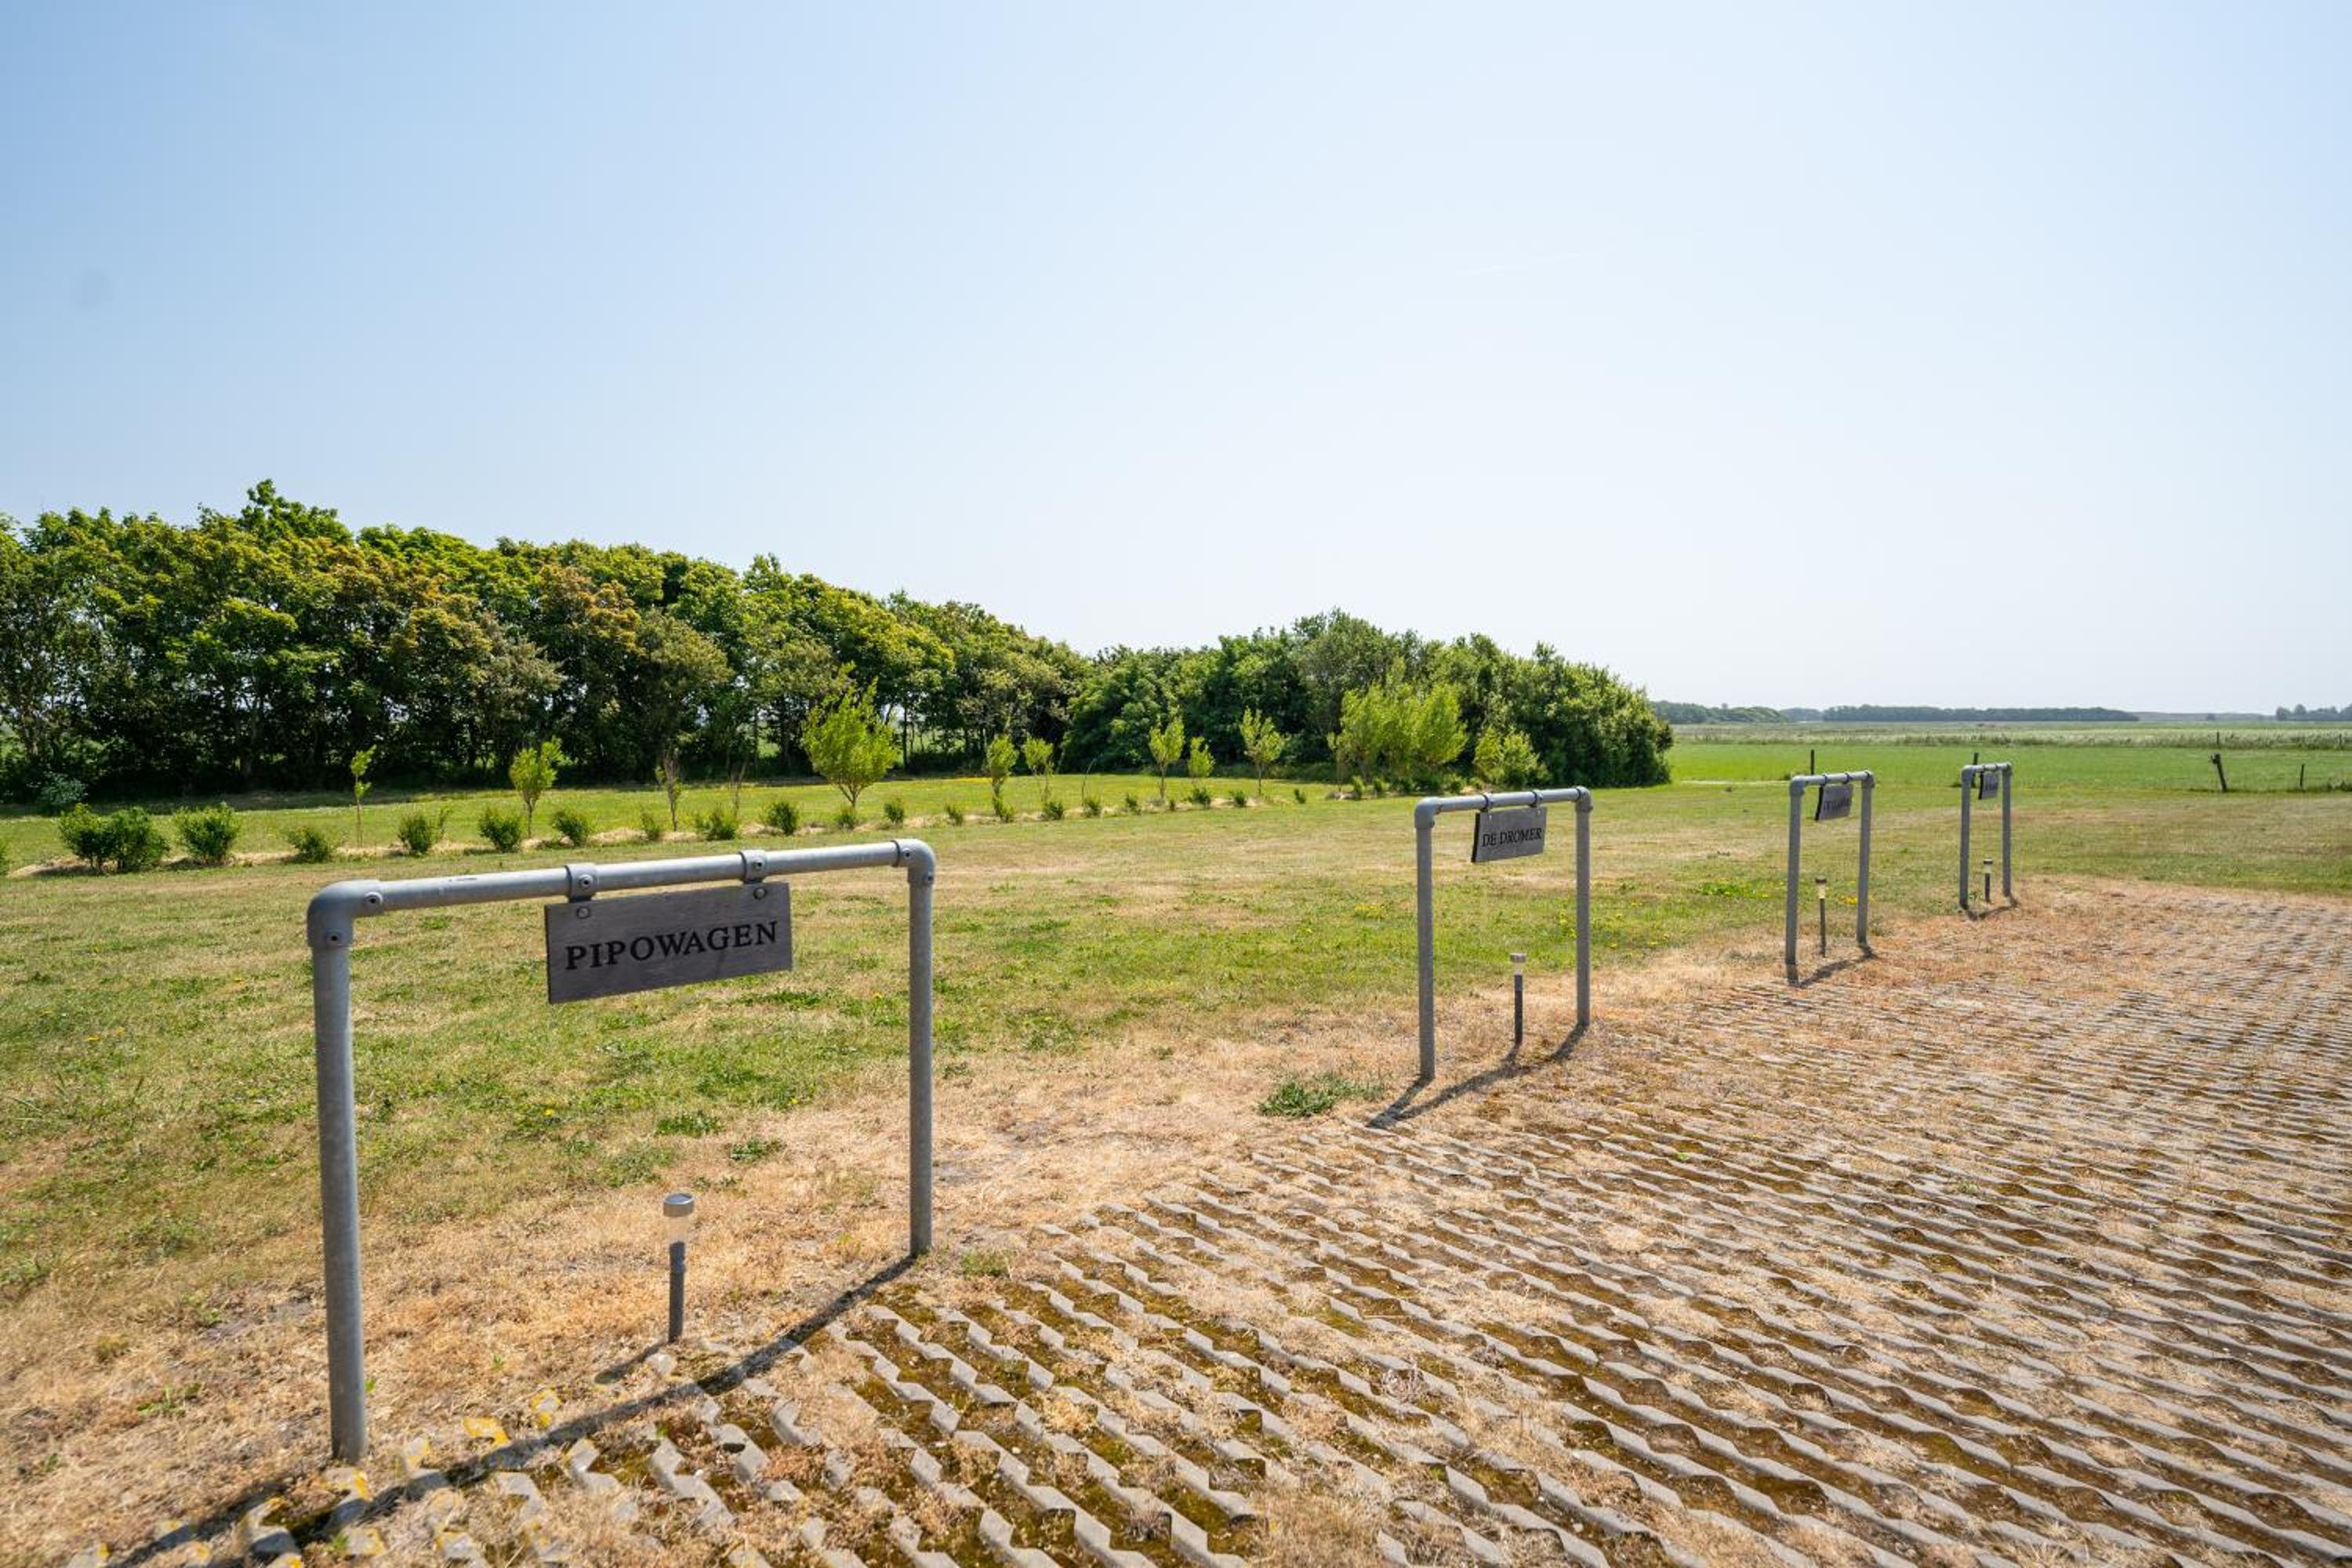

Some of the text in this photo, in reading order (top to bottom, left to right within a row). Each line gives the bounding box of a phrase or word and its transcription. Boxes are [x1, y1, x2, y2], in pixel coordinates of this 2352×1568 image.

[1482, 827, 1542, 848] DE DROMER
[564, 920, 779, 971] PIPOWAGEN
